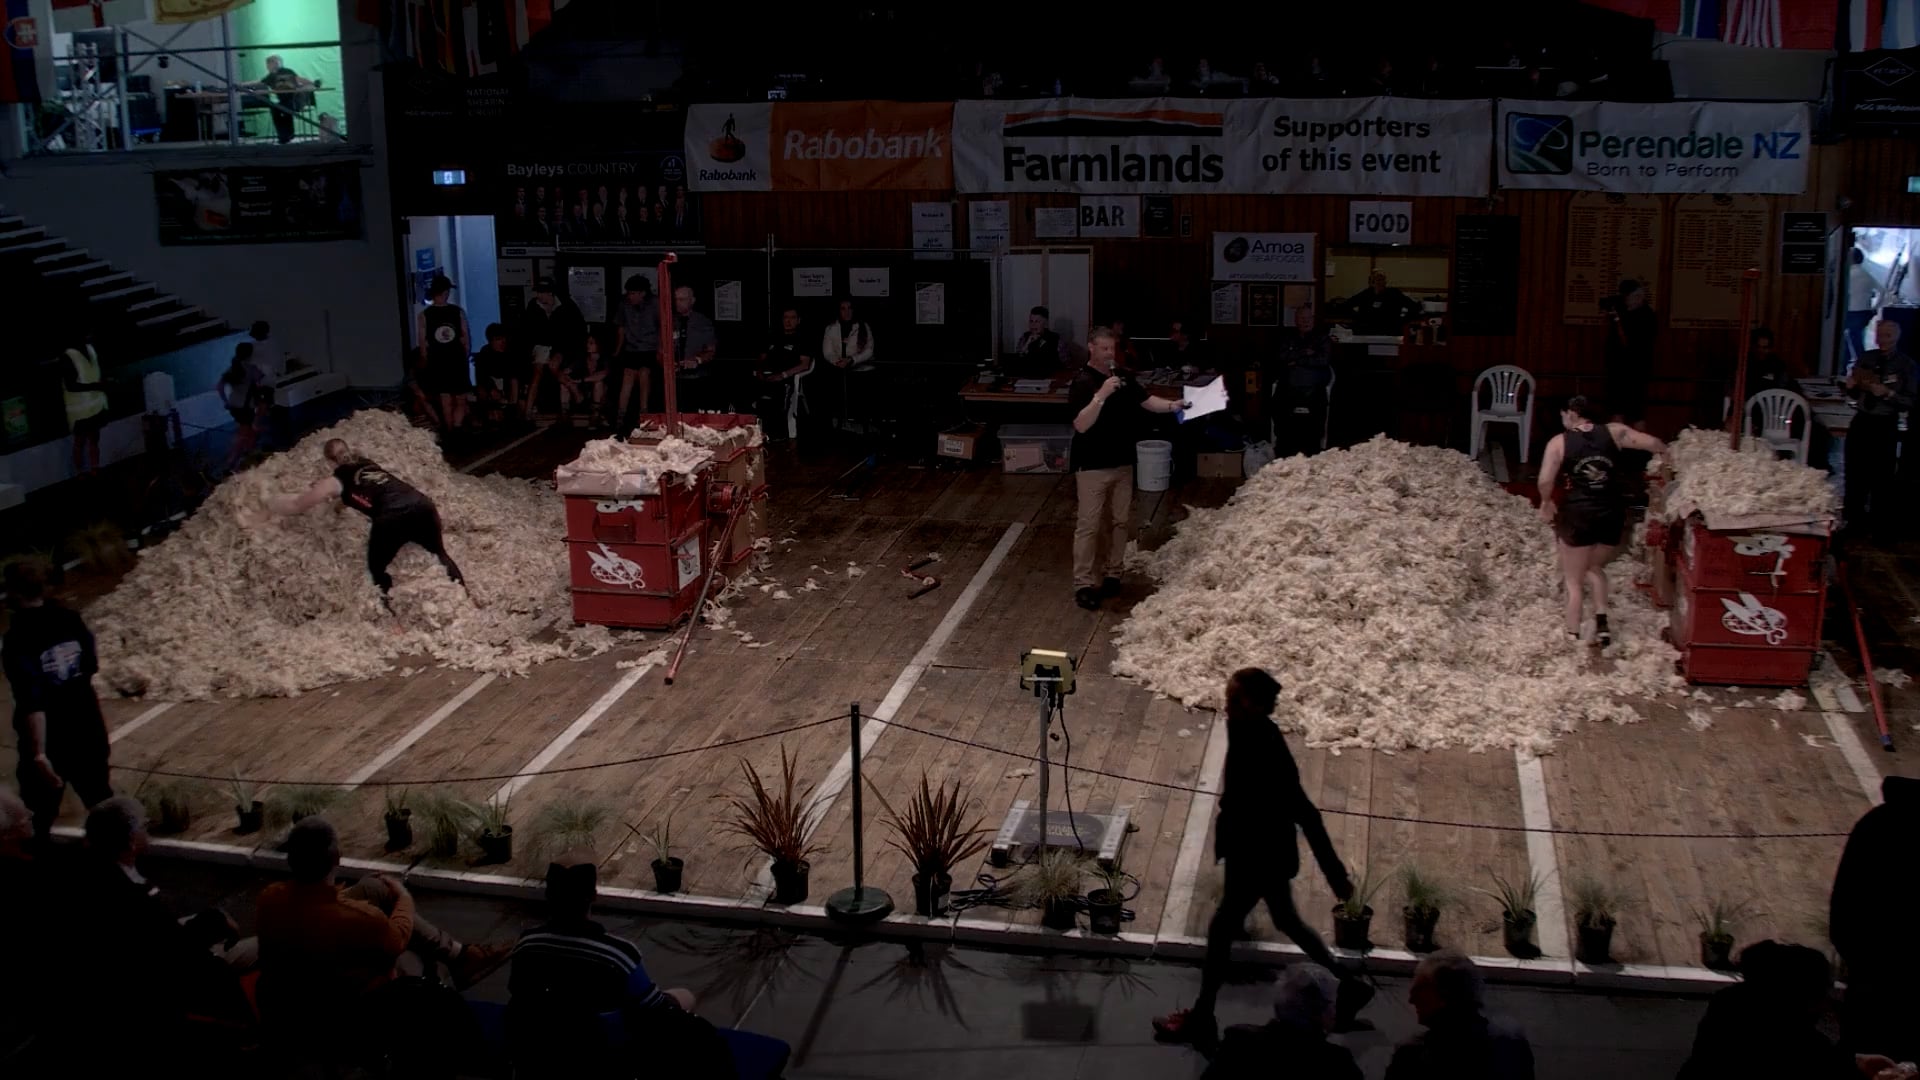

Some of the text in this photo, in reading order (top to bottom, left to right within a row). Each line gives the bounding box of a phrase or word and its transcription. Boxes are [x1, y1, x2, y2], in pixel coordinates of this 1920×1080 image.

[466, 97, 513, 107] SHEARIN
[1273, 115, 1431, 142] Supporters
[783, 127, 944, 161] Rabobank
[1578, 130, 1801, 160] Perendale NZ
[506, 162, 639, 178] Bayleys COUNTRY
[1003, 144, 1224, 183] Farmlands
[1262, 146, 1442, 173] of this event
[1586, 162, 1740, 178] Born to Perform
[699, 168, 757, 182] Rabobank
[1081, 205, 1125, 227] BAR
[1355, 213, 1410, 233] FOOD
[1251, 239, 1305, 254] Amoa
